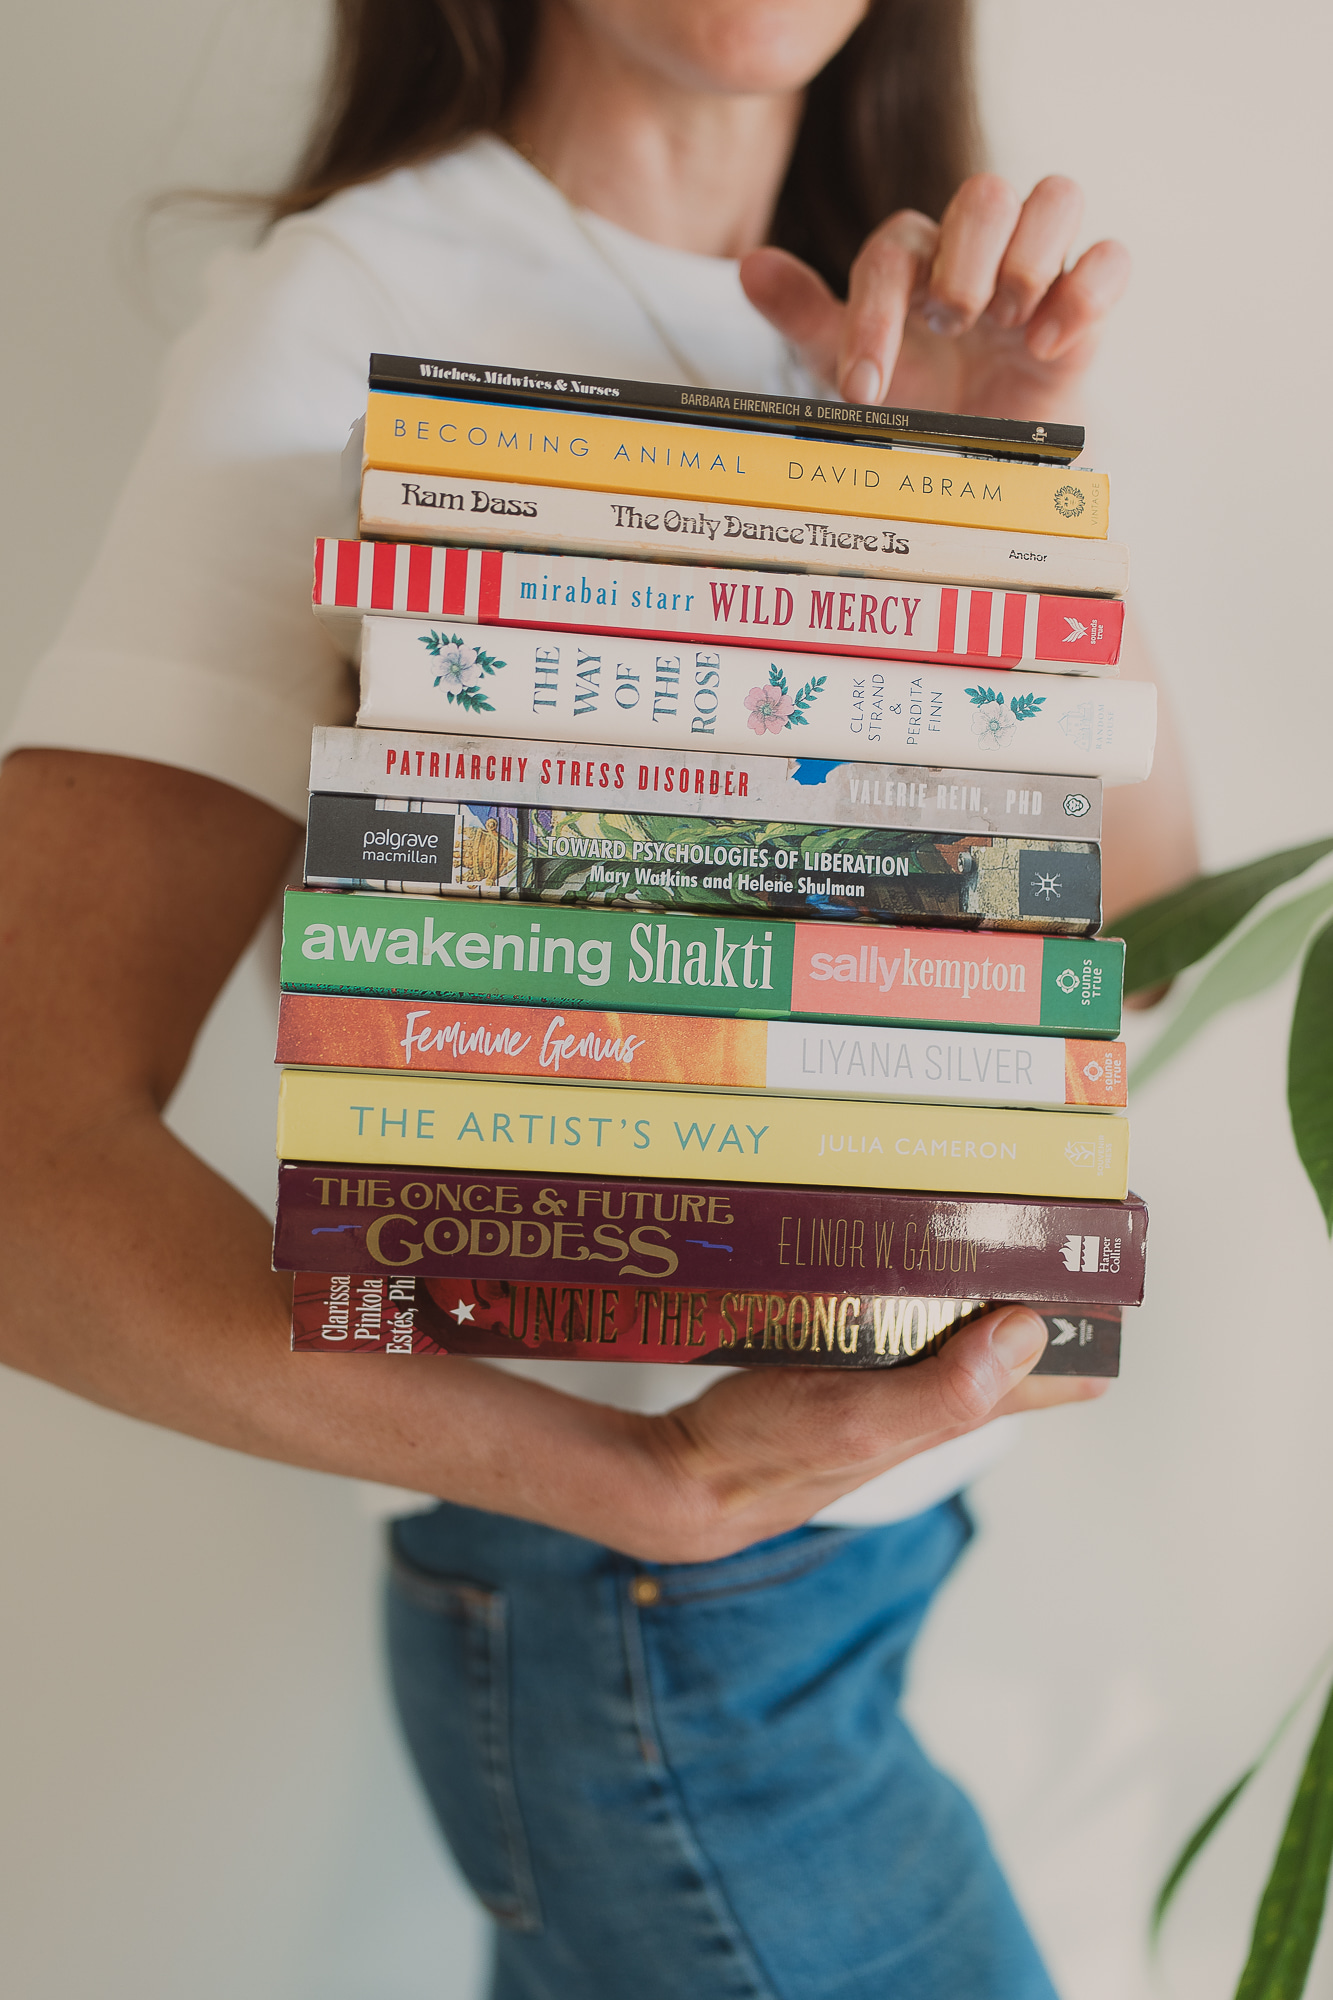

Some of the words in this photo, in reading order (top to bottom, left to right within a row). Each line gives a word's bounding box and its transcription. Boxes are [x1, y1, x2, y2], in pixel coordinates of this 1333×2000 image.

[484, 371, 552, 390] Midwives
[554, 379, 568, 392] &
[569, 380, 620, 397] Nurses
[681, 392, 731, 410] BARBARA
[733, 397, 800, 416] EHRENREICH
[804, 405, 813, 417] &
[817, 406, 863, 423] DEIRDRE
[865, 410, 909, 427] ENGLISH
[394, 418, 590, 457] BECOMING
[613, 443, 746, 474] ANIMAL
[401, 482, 464, 511] Ram
[470, 490, 538, 518] Dass
[788, 461, 880, 488] DAVID
[899, 474, 1003, 502] ABRAM
[1091, 483, 1100, 526] VINTAGE
[610, 504, 659, 531] The
[663, 509, 721, 541] Only
[723, 514, 805, 545] Dance
[804, 523, 879, 553] There
[881, 530, 910, 556] Is
[1008, 549, 1048, 564] Anchor
[520, 575, 617, 606] mirabai
[631, 585, 695, 611] starr
[709, 582, 794, 626] WILD
[810, 590, 921, 636] MERCY
[1090, 619, 1098, 645] sounds
[532, 646, 560, 715] THE
[573, 648, 602, 717] WAY
[614, 662, 640, 709] OF
[652, 655, 681, 722] THE
[691, 651, 721, 735] ROSE
[850, 678, 866, 734] CLARK
[868, 673, 885, 742] STRAND
[889, 703, 902, 715] &
[906, 677, 923, 745] PERDITA
[928, 691, 943, 733] FINN
[1096, 704, 1105, 750] RANDOM
[386, 748, 528, 783] PATRIARCHY
[540, 758, 625, 789] STRESS
[638, 765, 749, 797] DISORDER
[850, 778, 926, 809] VALERIE
[936, 785, 988, 814] REIN,
[1006, 789, 1042, 816] PHD
[362, 848, 438, 865] macmillan
[363, 829, 439, 850] palgrave
[546, 835, 626, 860] TOWARD
[632, 840, 769, 869] PSYCHOLOGIES
[774, 849, 798, 871] OF
[804, 850, 909, 877] LIBERATION
[589, 865, 631, 888] Mary
[634, 868, 698, 889] Watkins
[703, 872, 732, 891] and
[737, 873, 794, 893] Helene
[797, 877, 865, 898] Shulman
[301, 916, 613, 987] awakening
[627, 921, 774, 990] Shakti
[400, 1010, 531, 1064] Feminine
[539, 1015, 646, 1071] Genius
[801, 1037, 914, 1080] LIYANA
[924, 1044, 1033, 1085] SILVER
[349, 1105, 435, 1140] THE
[457, 1112, 651, 1150] ARTIST’S
[674, 1121, 770, 1155] WAY
[818, 1134, 884, 1156] JULIA
[895, 1138, 1018, 1160] CAMERON
[1097, 1135, 1105, 1176] SOUVENIR
[1104, 1143, 1113, 1169] PRESS
[312, 1176, 395, 1208] THE
[399, 1181, 523, 1215] ONCE
[532, 1187, 568, 1217] &
[577, 1190, 735, 1225] FUTURE
[365, 1213, 679, 1279] GODDESS
[778, 1216, 866, 1268] ELINOR
[875, 1221, 895, 1270] W.
[1099, 1236, 1111, 1273] Harper
[1110, 1237, 1122, 1274] Collins
[321, 1274, 351, 1341] Clarissa
[354, 1278, 383, 1341] Pinkola
[389, 1275, 416, 1301] Ph
[386, 1307, 419, 1354] Estés,
[508, 1285, 619, 1344] UNTIE
[635, 1289, 709, 1347] THE
[720, 1292, 861, 1354] STRONG
